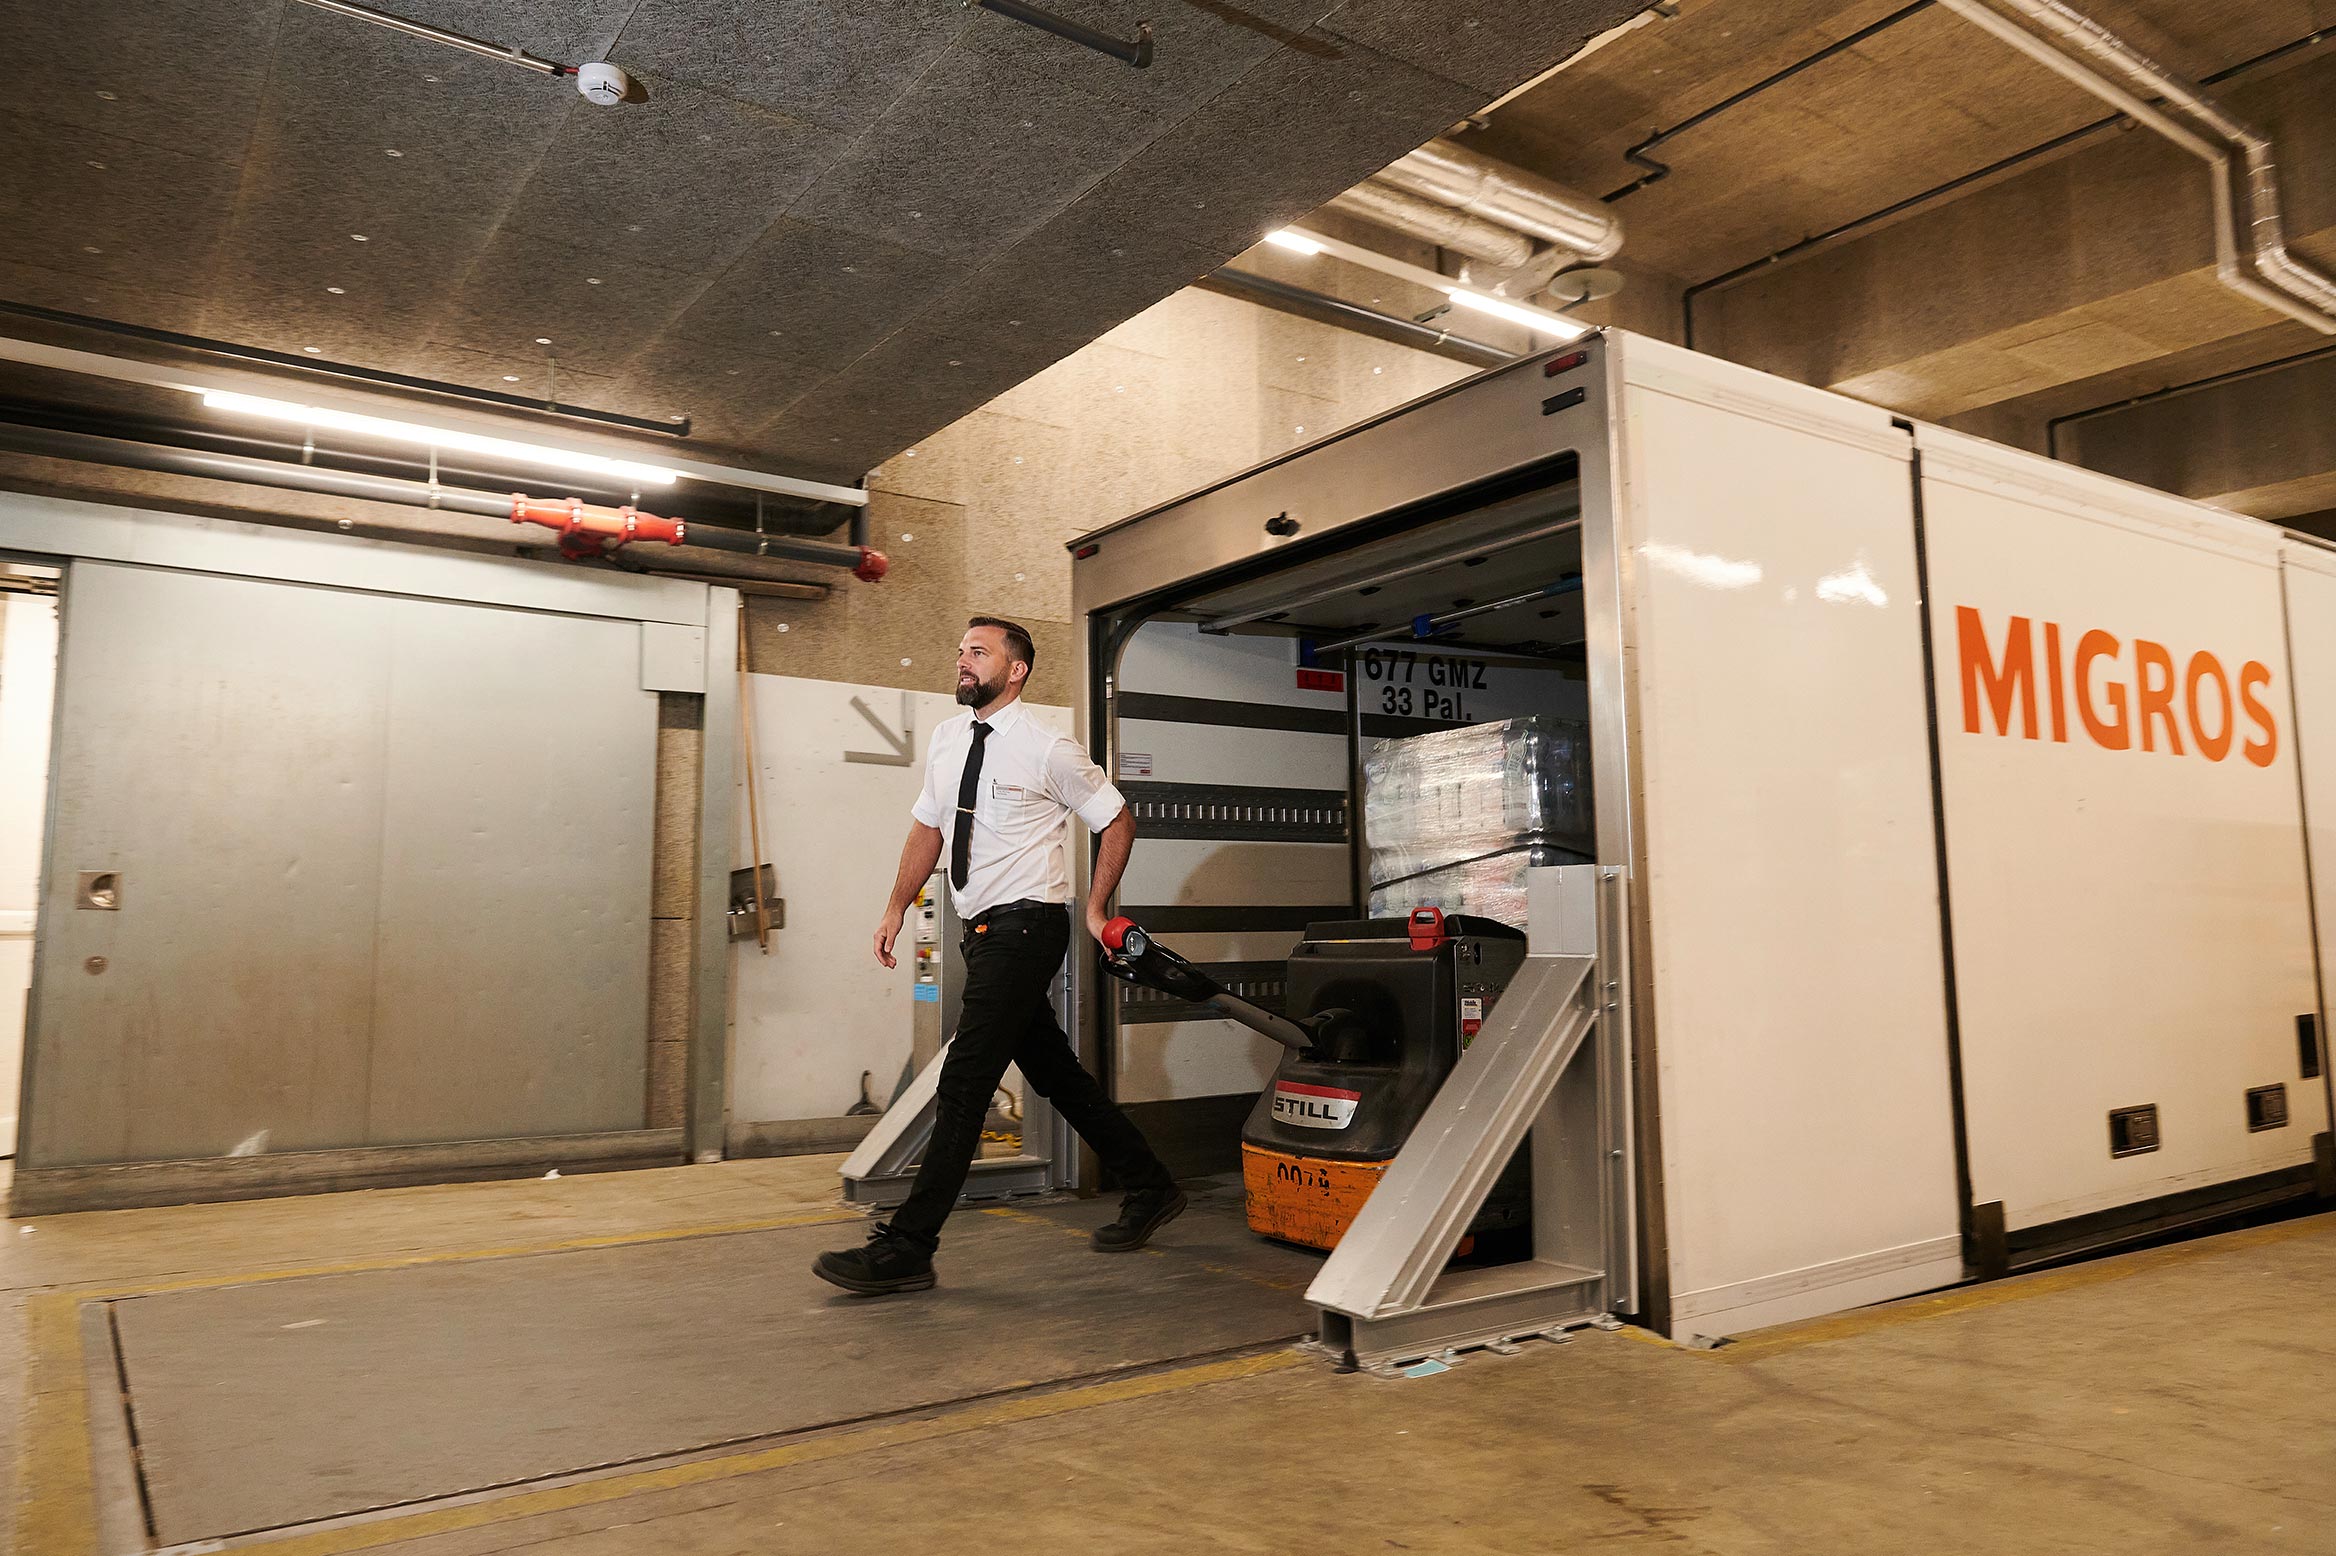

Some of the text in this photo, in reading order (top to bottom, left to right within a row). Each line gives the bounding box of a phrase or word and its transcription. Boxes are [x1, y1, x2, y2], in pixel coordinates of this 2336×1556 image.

[1365, 648, 1488, 690] 677 GMZ
[1955, 604, 2278, 767] MIGROS
[1382, 686, 1472, 720] 33 Pal.
[1273, 1096, 1338, 1121] STILL
